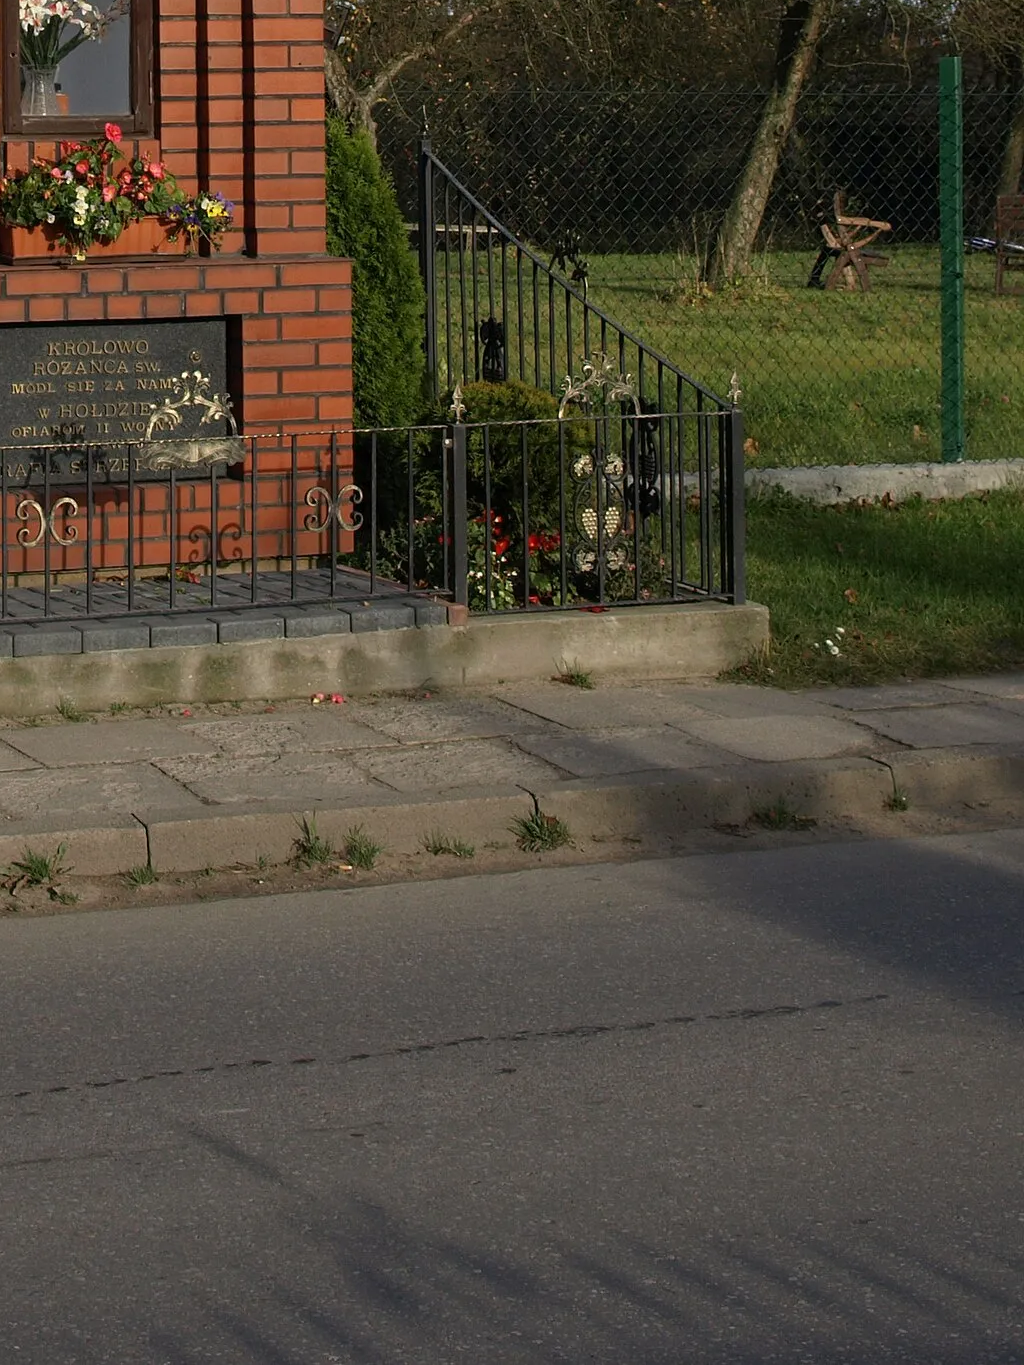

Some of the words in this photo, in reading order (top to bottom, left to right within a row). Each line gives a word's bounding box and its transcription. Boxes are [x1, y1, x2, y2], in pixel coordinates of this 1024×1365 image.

[104, 380, 125, 392] ZA
[136, 378, 177, 391] NAM
[97, 422, 109, 434] II
[120, 420, 175, 433] WONY
